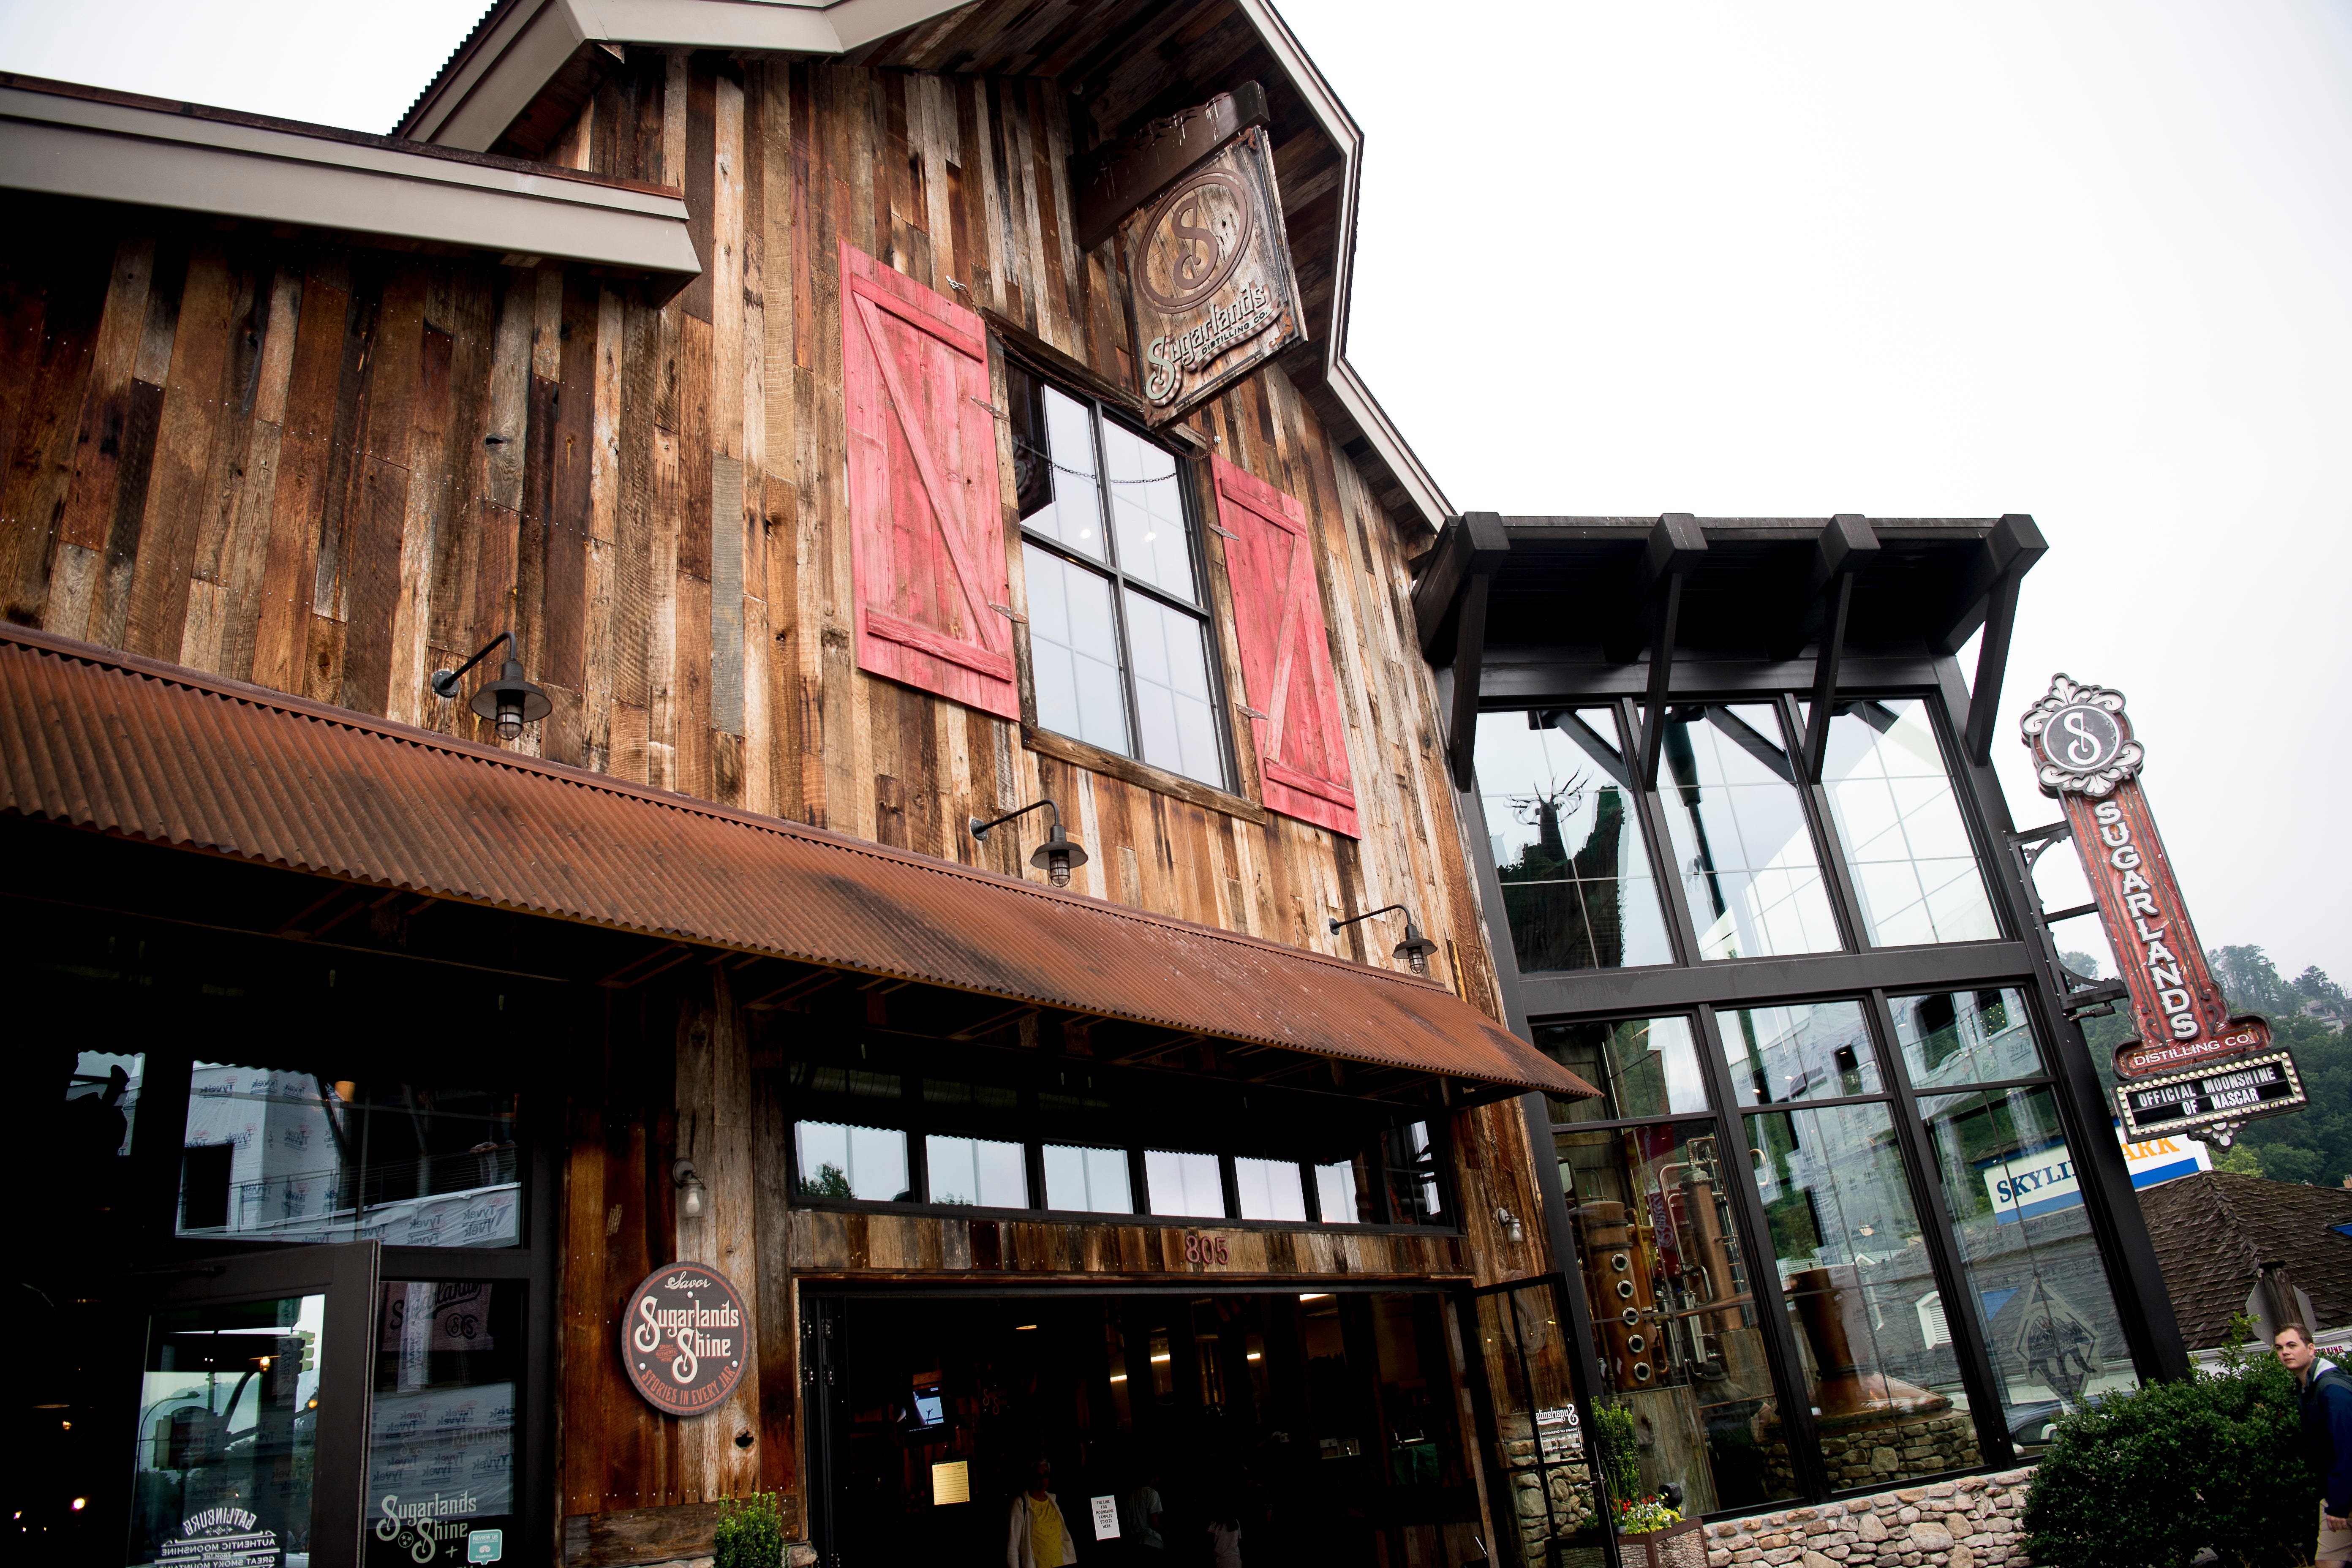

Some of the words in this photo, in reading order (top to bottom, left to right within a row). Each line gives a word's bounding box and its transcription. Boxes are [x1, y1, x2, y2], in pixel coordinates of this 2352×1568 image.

[1146, 281, 1266, 400] Sugarlands
[1201, 323, 1250, 356] DISTILLING
[1253, 311, 1268, 324] CO.
[2063, 711, 2101, 765] S
[2094, 801, 2199, 1039] SUGARLANDS
[2134, 1040, 2220, 1066] DISTILLING
[2225, 1034, 2252, 1046] CO.
[2137, 1084, 2196, 1107] OFFICIAL
[2202, 1066, 2276, 1094] MOONSHINE
[2182, 1100, 2198, 1116] OF
[2210, 1088, 2259, 1109] NASCAR
[2121, 1138, 2180, 1161] ARK
[1996, 1160, 2077, 1203] SKYLI
[1185, 1235, 1230, 1265] 805
[665, 1271, 711, 1289] Savor
[634, 1296, 739, 1352] Sugarlands
[672, 1327, 731, 1383] Shine
[641, 1369, 678, 1404] STORIES
[680, 1390, 689, 1405] IN
[691, 1380, 720, 1405] EVERY
[719, 1365, 736, 1388] JAR
[376, 1490, 477, 1541] Sugarlands
[411, 1517, 468, 1564] Shine
